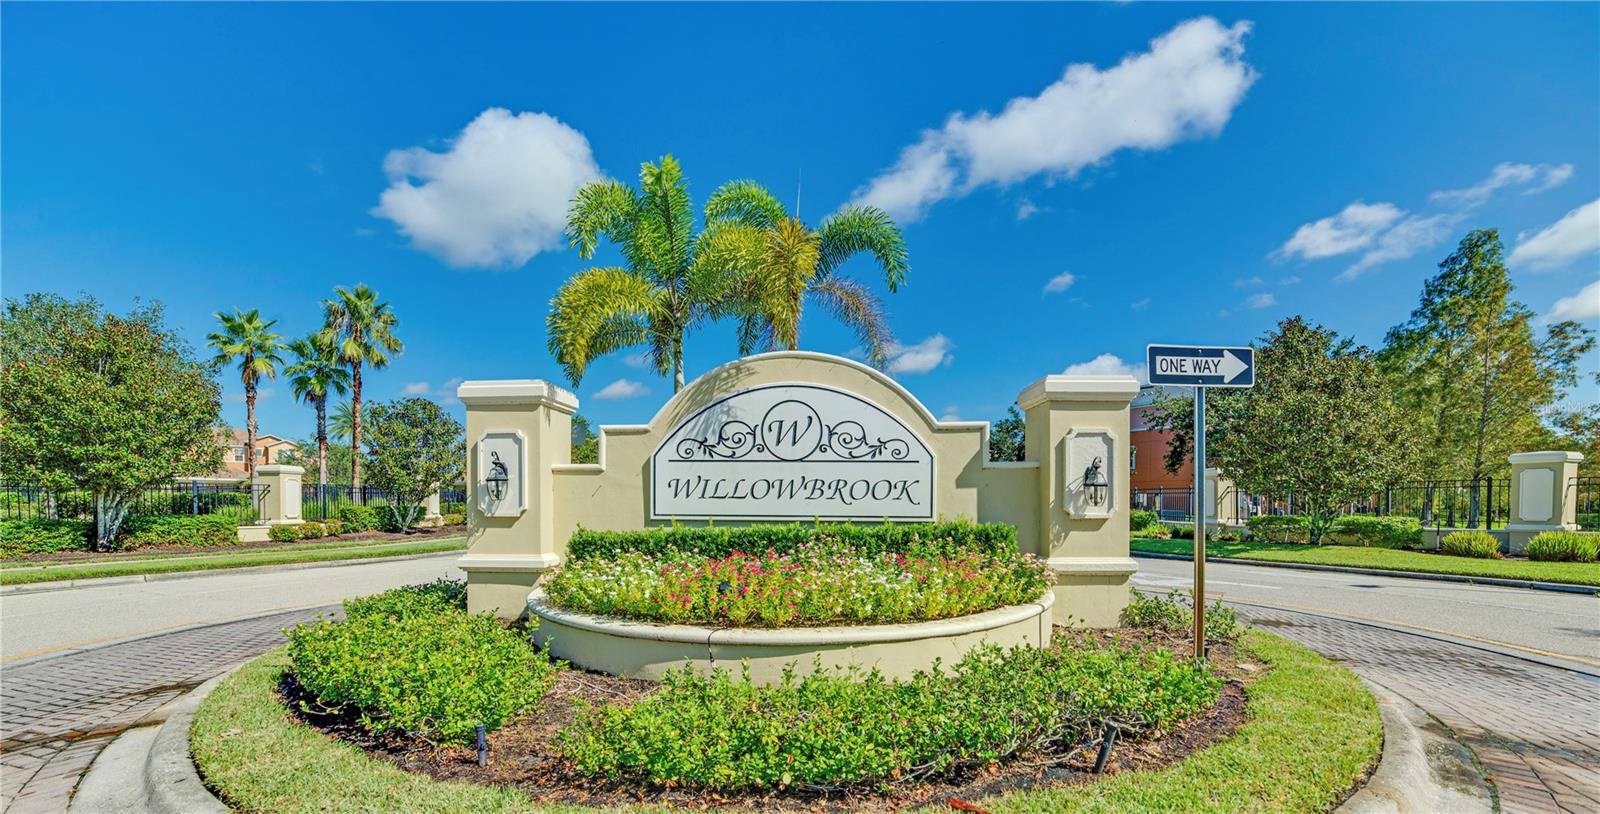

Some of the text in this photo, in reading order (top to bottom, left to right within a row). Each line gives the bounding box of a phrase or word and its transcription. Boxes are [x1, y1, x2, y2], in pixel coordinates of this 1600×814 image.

[1160, 358, 1221, 374] ONE WAY
[768, 415, 813, 447] W
[668, 476, 921, 505] WILLOWBROOK
